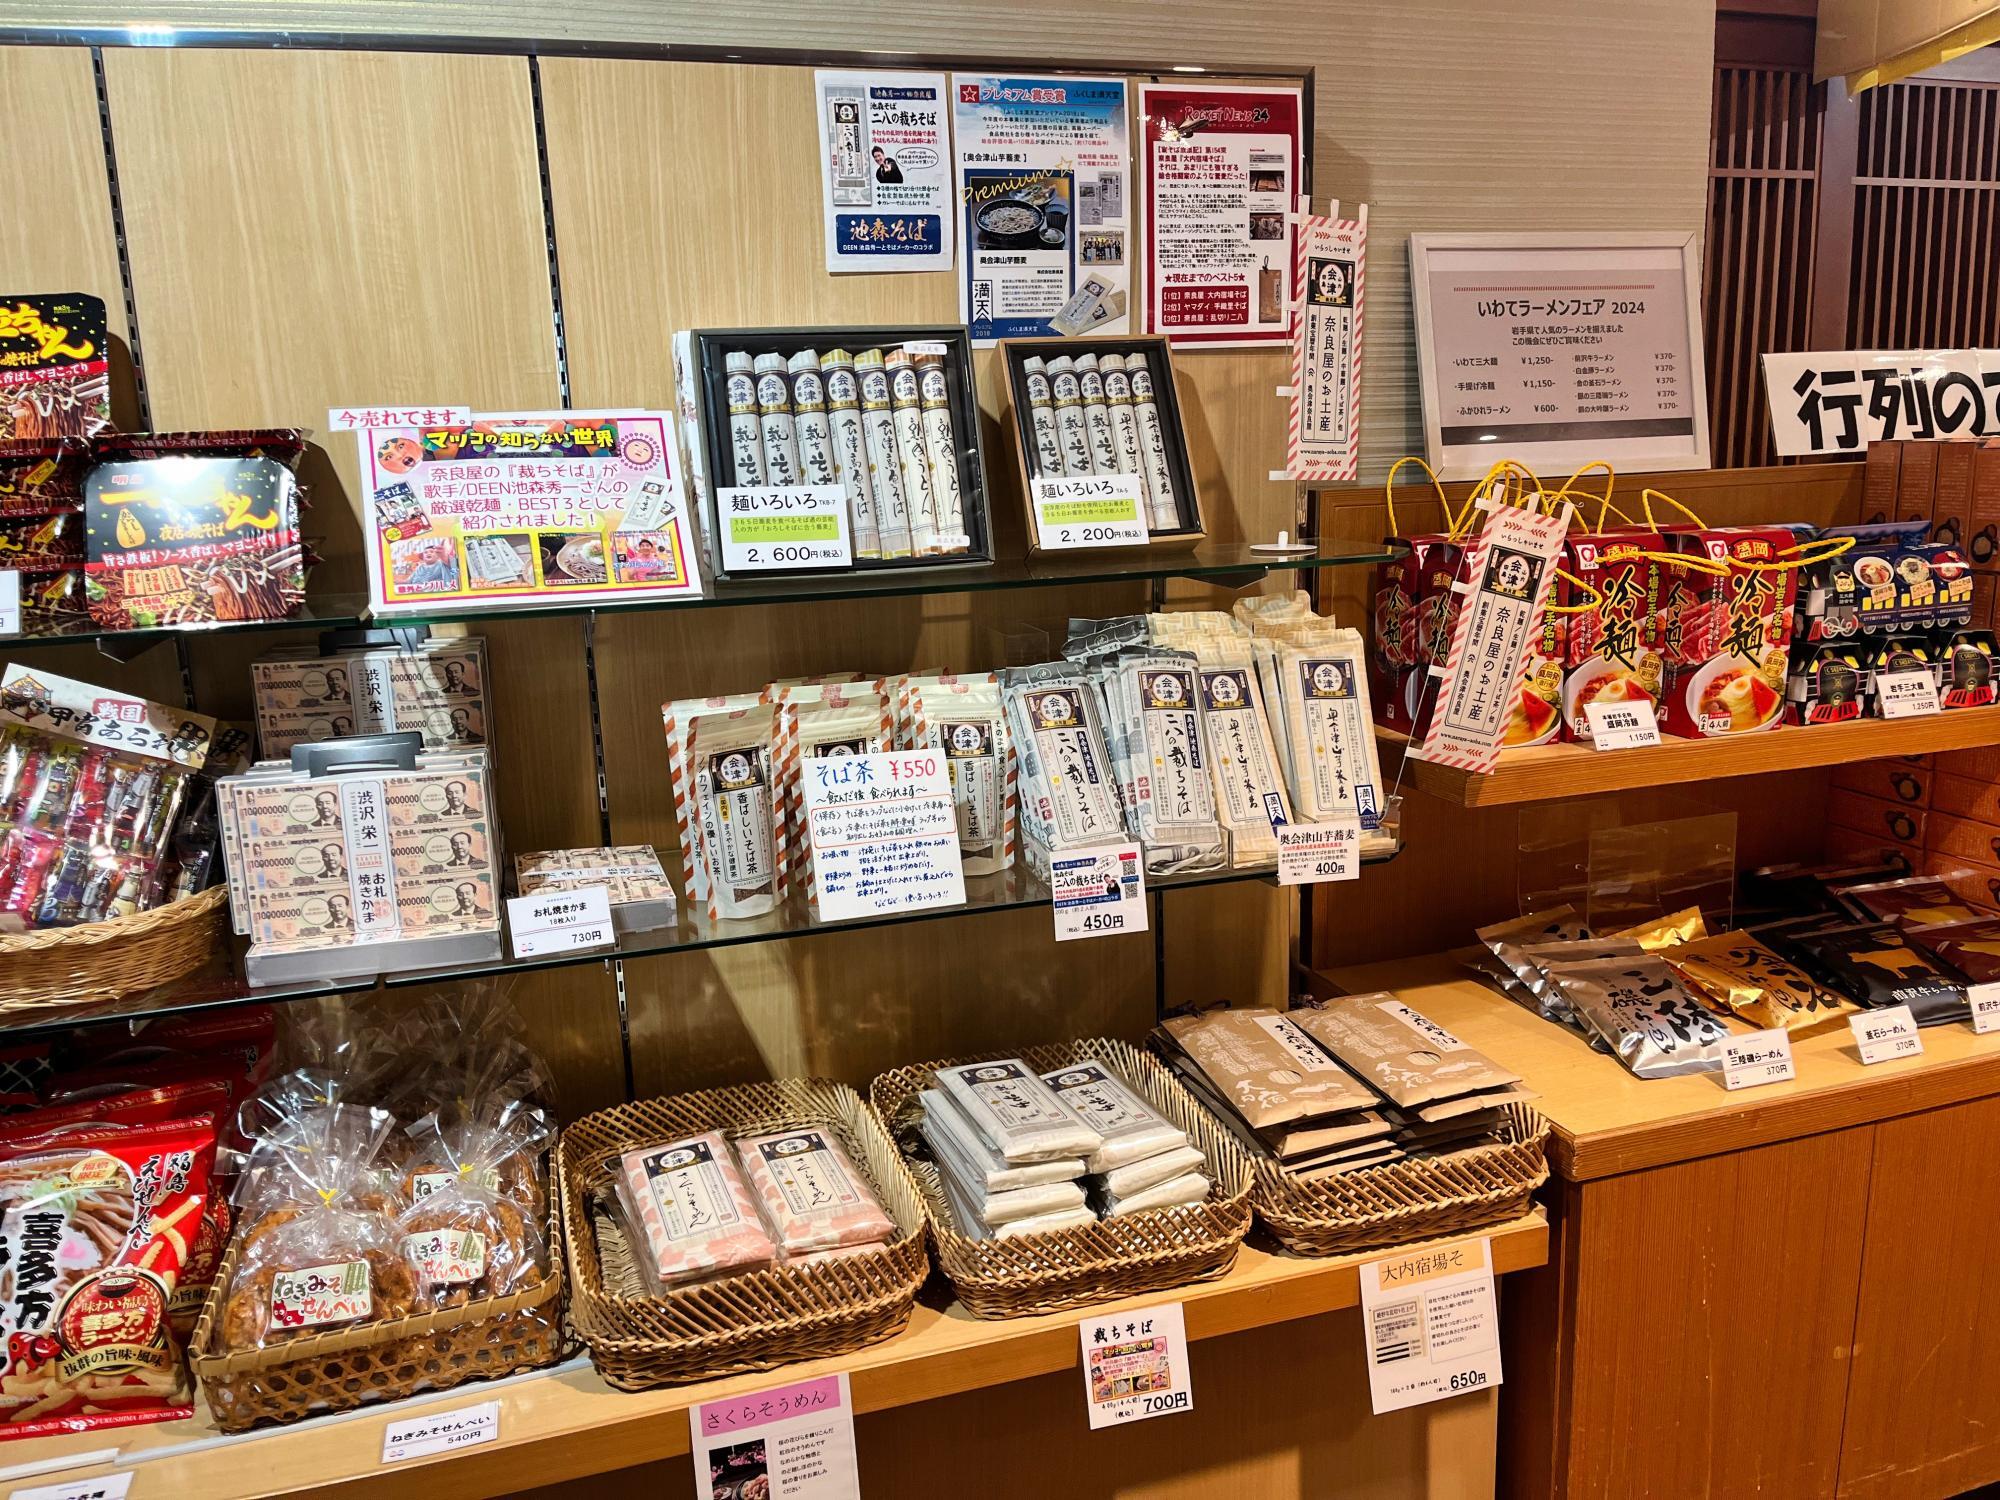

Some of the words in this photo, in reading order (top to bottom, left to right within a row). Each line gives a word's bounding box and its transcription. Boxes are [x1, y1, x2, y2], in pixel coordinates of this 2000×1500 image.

[983, 87, 1066, 103] プレミアム賞受賞
[871, 111, 937, 126] 二八の裁ちそば
[961, 167, 1053, 206] Premium
[850, 217, 928, 242] 池森そば
[1478, 299, 1606, 318] いわてラーメンフェア
[1611, 301, 1646, 315] 2024
[1511, 325, 1624, 336] 岩手県で人気のラーメンを揃えました
[1511, 335, 1603, 346] この機会にぜひご賞味ください
[1319, 315, 1336, 432] 奈良屋のお土産
[338, 410, 468, 428] 今売れてます。
[425, 427, 615, 450] マツコの知らない世界
[430, 464, 619, 481] 奈良屋の『裁ちそば』が
[423, 481, 629, 498] 歌手/DEEN池森秀一さんの
[1040, 481, 1114, 499] 麺いろいろ
[731, 493, 818, 512] 麺いろいろ
[462, 513, 598, 530] 紹介されました！
[1645, 562, 1660, 645] 本場岩手名物
[1467, 606, 1511, 722] 奈良屋のお土産
[365, 669, 385, 721] 渋沢栄一
[816, 760, 874, 787] そば茶
[888, 758, 936, 781] ¥550
[963, 760, 980, 838] 香ばしいそば茶
[357, 790, 379, 848] 渋沢栄一
[736, 792, 759, 875] 香ばしいそば茶
[1280, 829, 1355, 845] 奥会津山芋蕎麦
[1315, 862, 1345, 874] 400円
[374, 873, 388, 898] お札
[358, 874, 375, 924] 焼きかま
[534, 902, 588, 918] お札焼きかま
[549, 914, 577, 926] 18枚入り
[1083, 914, 1124, 930] 450円
[571, 930, 602, 944] 730円
[1865, 1024, 1907, 1040] 釜石らーめん
[1896, 1040, 1916, 1051] 370円
[1730, 1049, 1783, 1067] 三陸磯らーめん
[1767, 1063, 1788, 1075] 370円
[14, 1211, 66, 1331] 喜多方
[422, 1258, 480, 1280] せんべい
[1381, 1250, 1464, 1284] 大内宿場そ
[272, 1274, 343, 1302] ねぎみそ
[80, 1295, 150, 1313] 味わい福島
[299, 1297, 369, 1320] せんべい
[79, 1310, 147, 1332] 喜多方
[80, 1327, 146, 1346] ラーメン
[63, 1347, 165, 1377] 抜群の旨味・風味
[1450, 1370, 1488, 1390] 650円
[707, 1390, 828, 1429] さくらそうめん
[1143, 1392, 1188, 1412] 700円
[390, 1416, 491, 1444] ねぎみそせんべい
[447, 1430, 483, 1445] 540円
